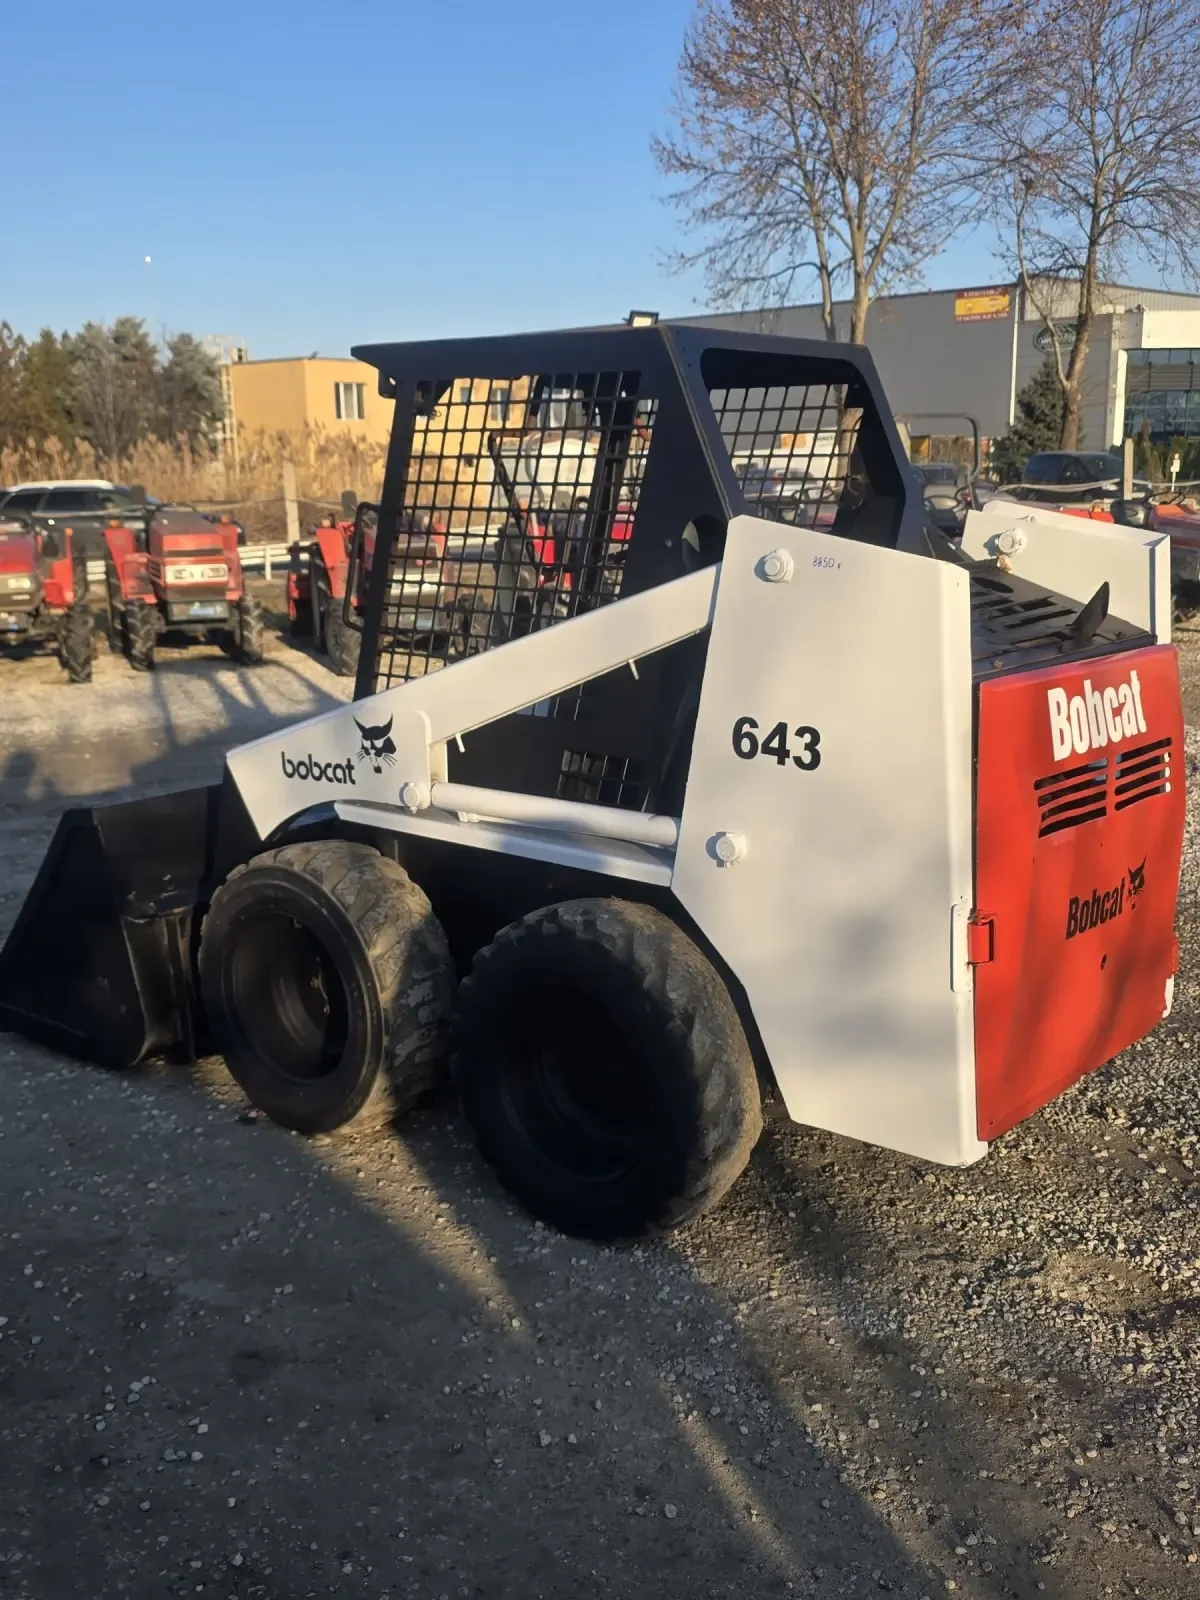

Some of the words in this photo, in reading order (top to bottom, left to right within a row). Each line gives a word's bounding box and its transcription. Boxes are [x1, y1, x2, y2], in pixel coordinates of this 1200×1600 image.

[732, 716, 821, 771] 643
[1047, 670, 1147, 761] Bobcat
[281, 751, 356, 785] bobcat
[1065, 877, 1126, 940] Bobcat
